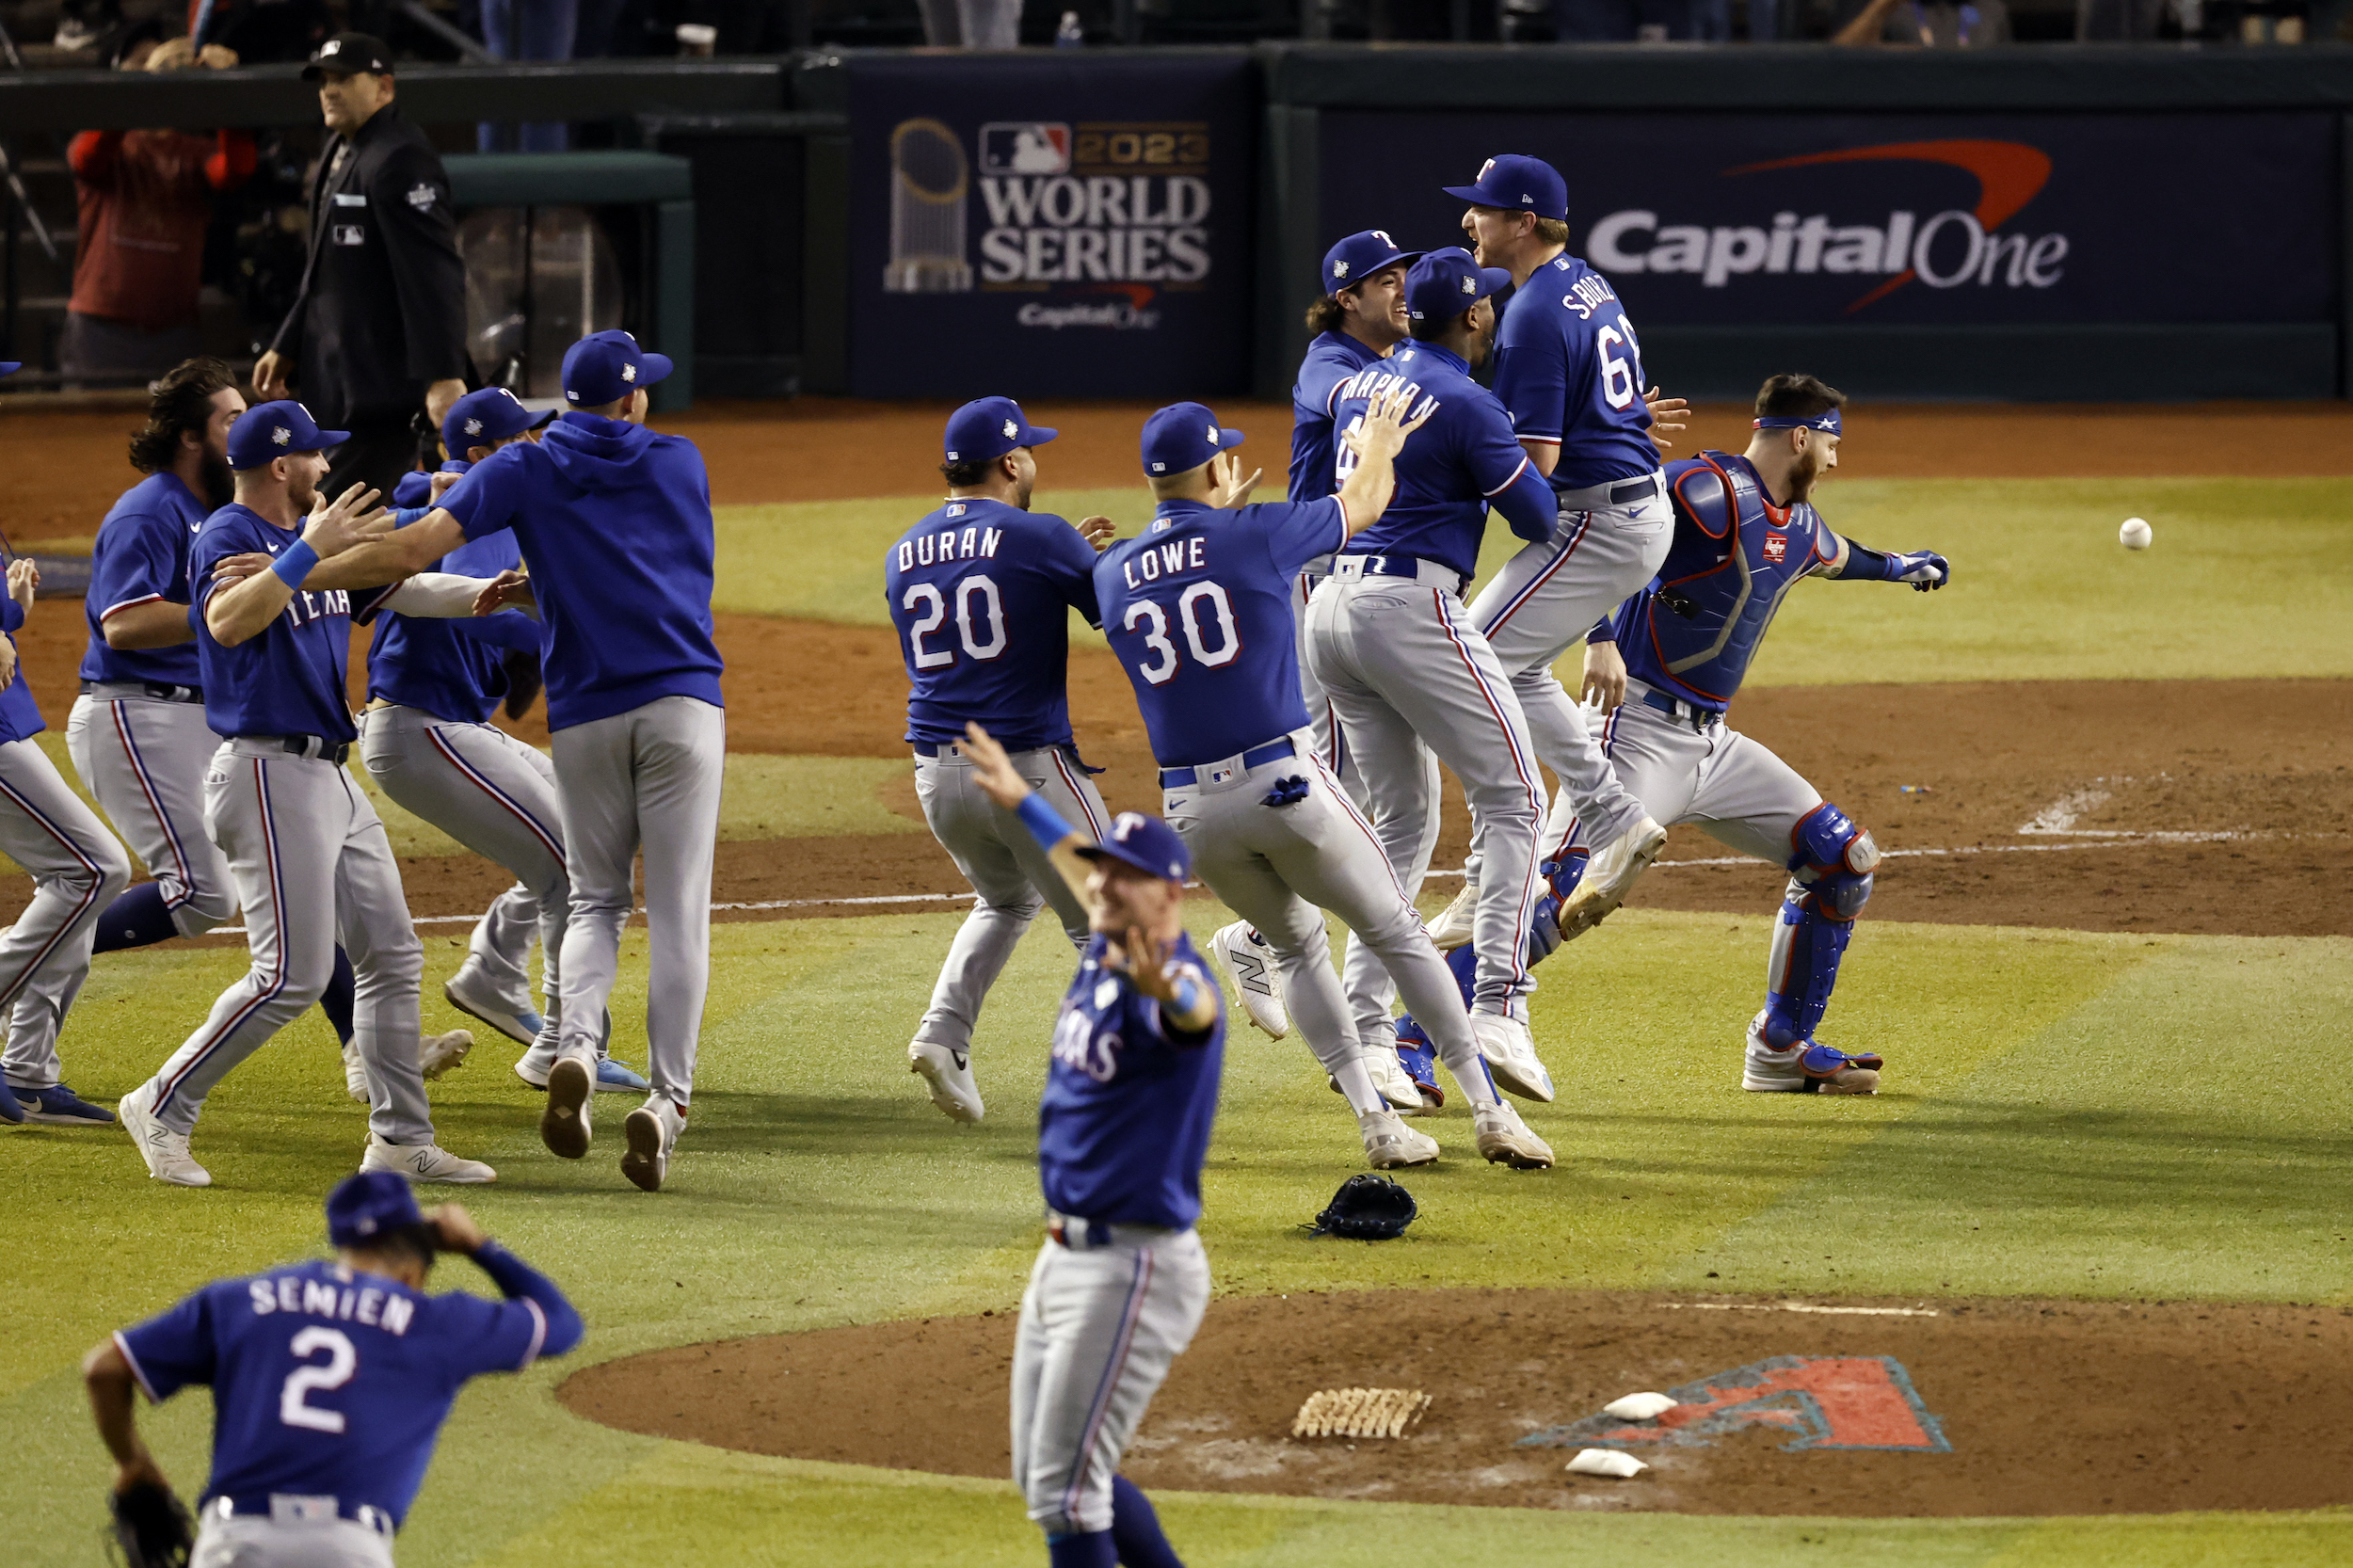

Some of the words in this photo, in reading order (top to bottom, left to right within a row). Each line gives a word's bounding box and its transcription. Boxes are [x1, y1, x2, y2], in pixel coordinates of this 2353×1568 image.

[1076, 132, 1209, 165] 2023
[979, 175, 1211, 227] WORLD
[980, 226, 1211, 282] SERIES
[1370, 229, 1399, 250] T
[898, 526, 1004, 573] DURAN
[1123, 536, 1209, 590] LOWE
[902, 573, 1011, 671] 20
[1123, 579, 1244, 687] 30
[1112, 810, 1146, 842] T
[248, 1275, 415, 1336] SEMIEN
[280, 1324, 358, 1434] 2
